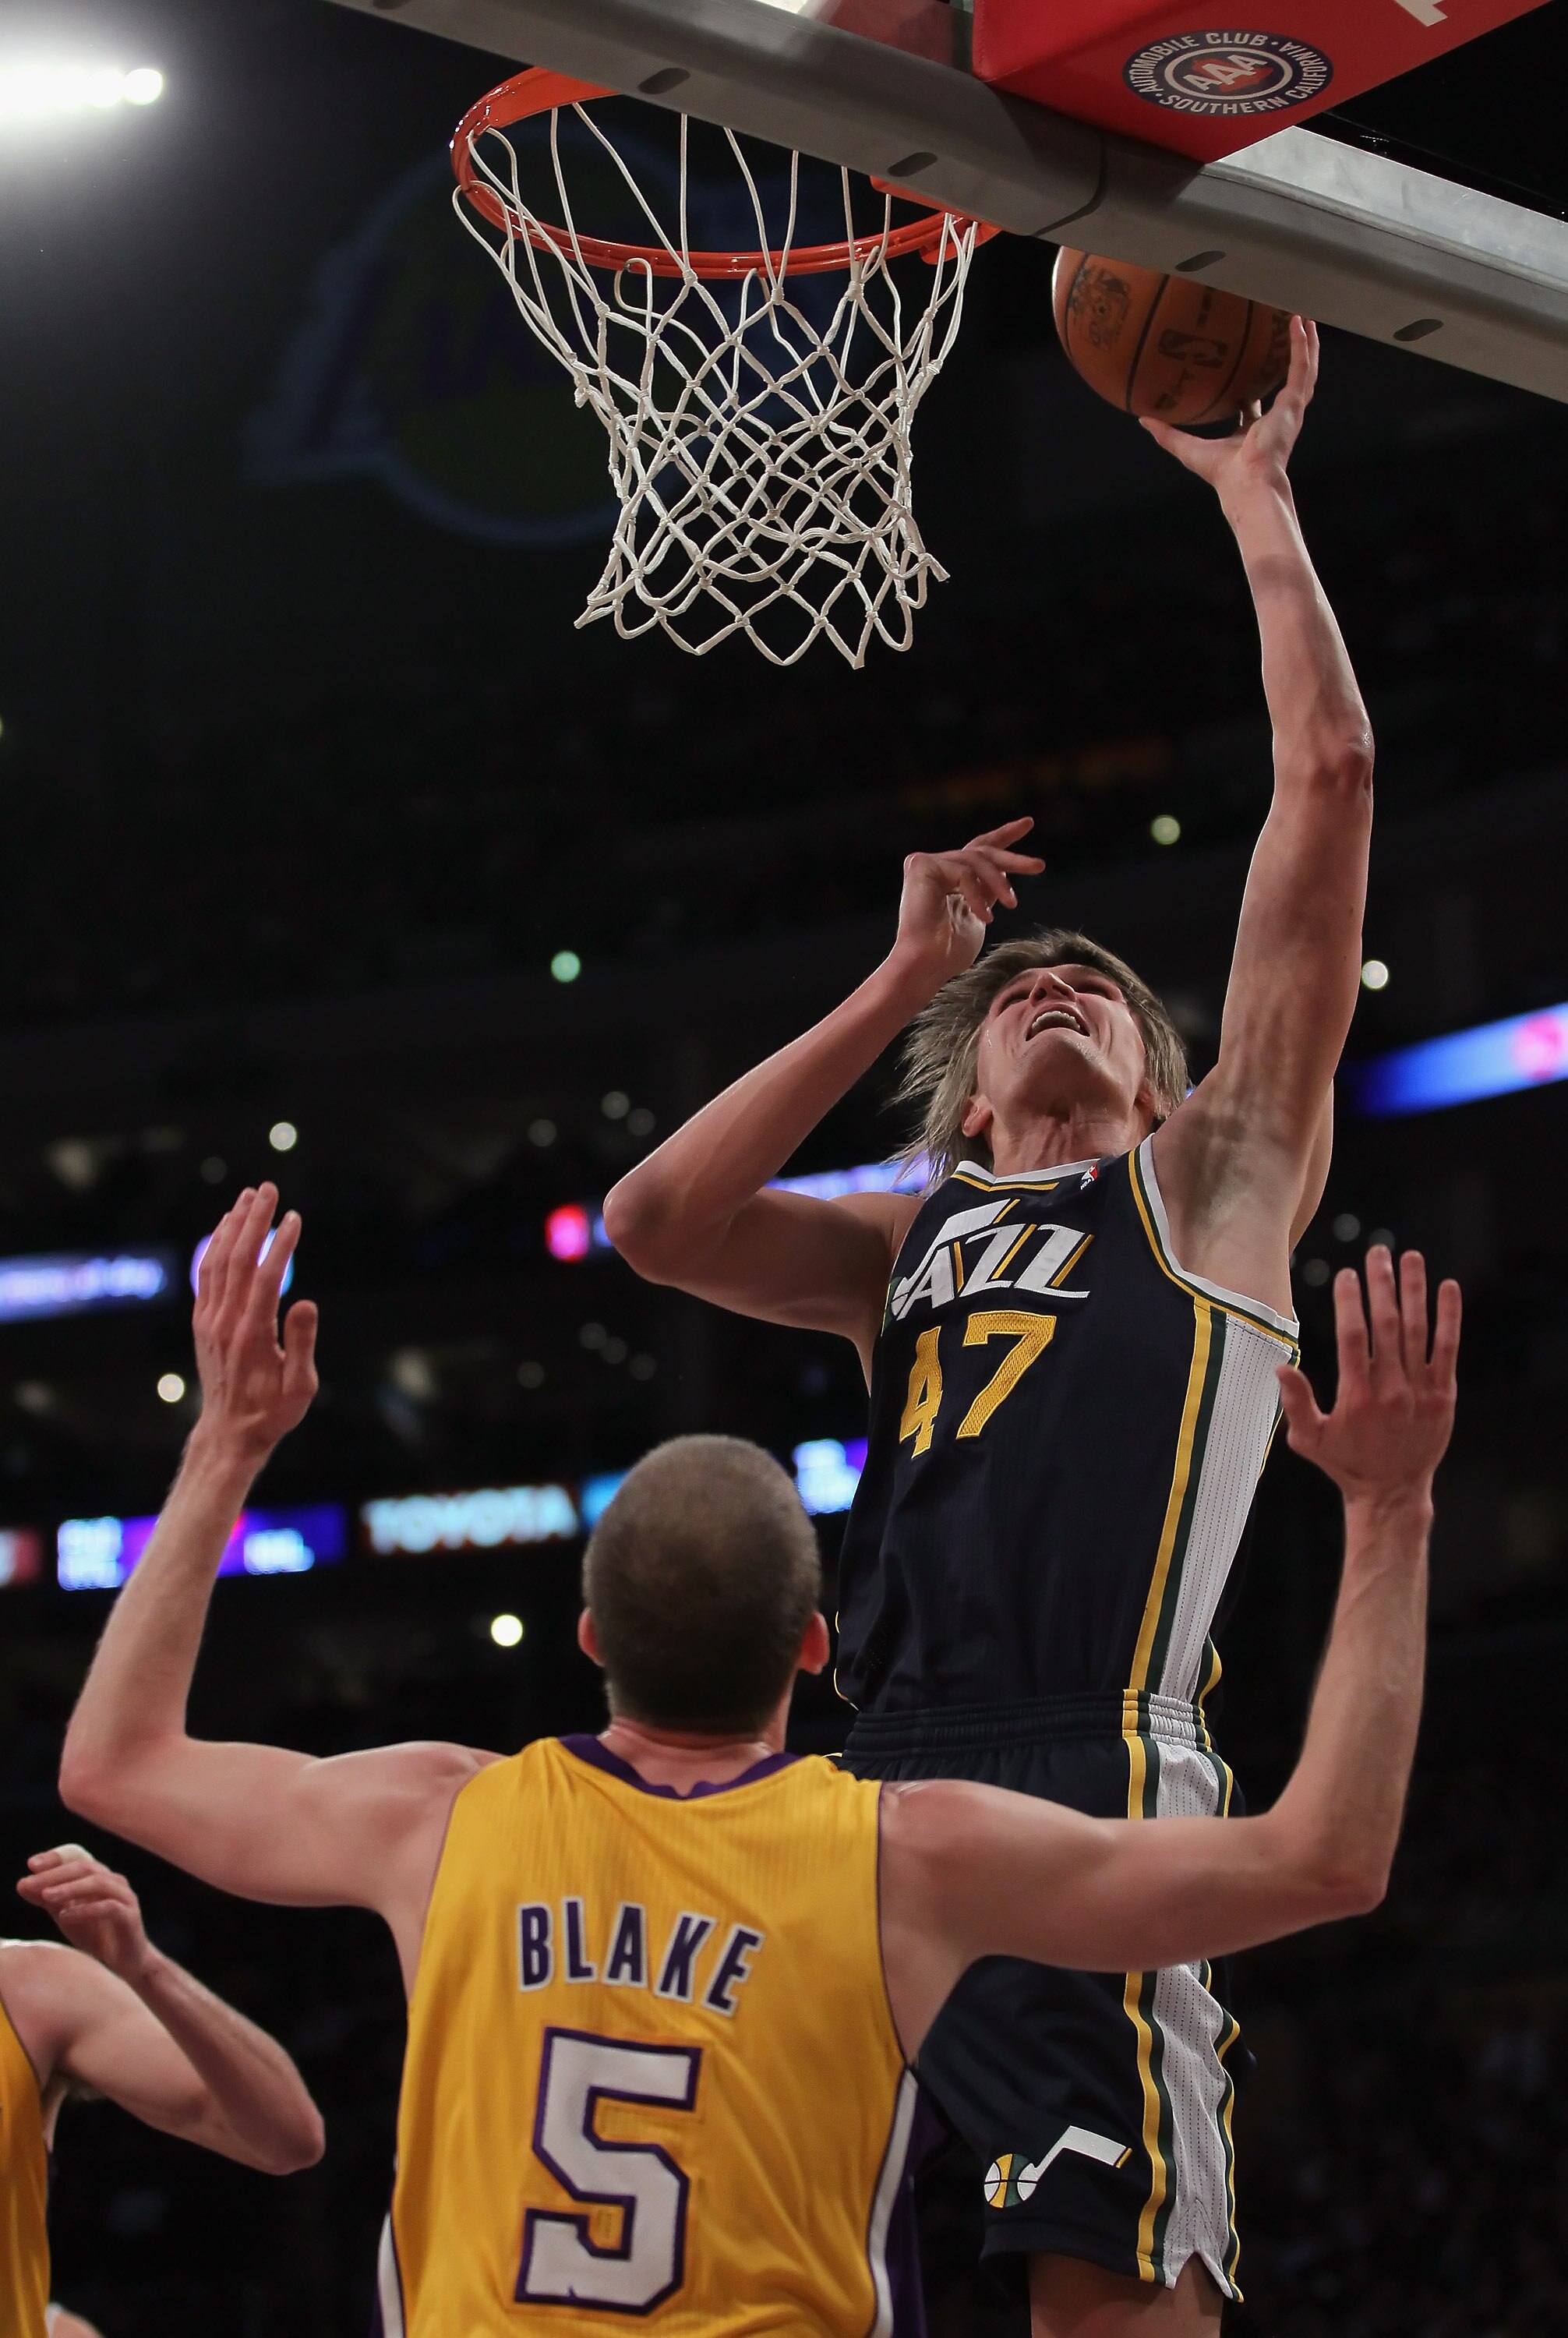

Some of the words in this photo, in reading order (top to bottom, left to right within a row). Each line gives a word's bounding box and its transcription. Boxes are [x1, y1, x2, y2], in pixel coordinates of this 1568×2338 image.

[1128, 35, 1200, 94] AUTOMOBILE
[1205, 32, 1269, 46] CLUB
[1159, 94, 1290, 115] SOUTHERN
[1280, 41, 1329, 100] CALIFORNIA
[1182, 54, 1268, 91] AAA
[899, 1309, 1057, 1460] 47
[517, 1896, 765, 2018] BLAKE
[514, 2026, 702, 2317] 5
